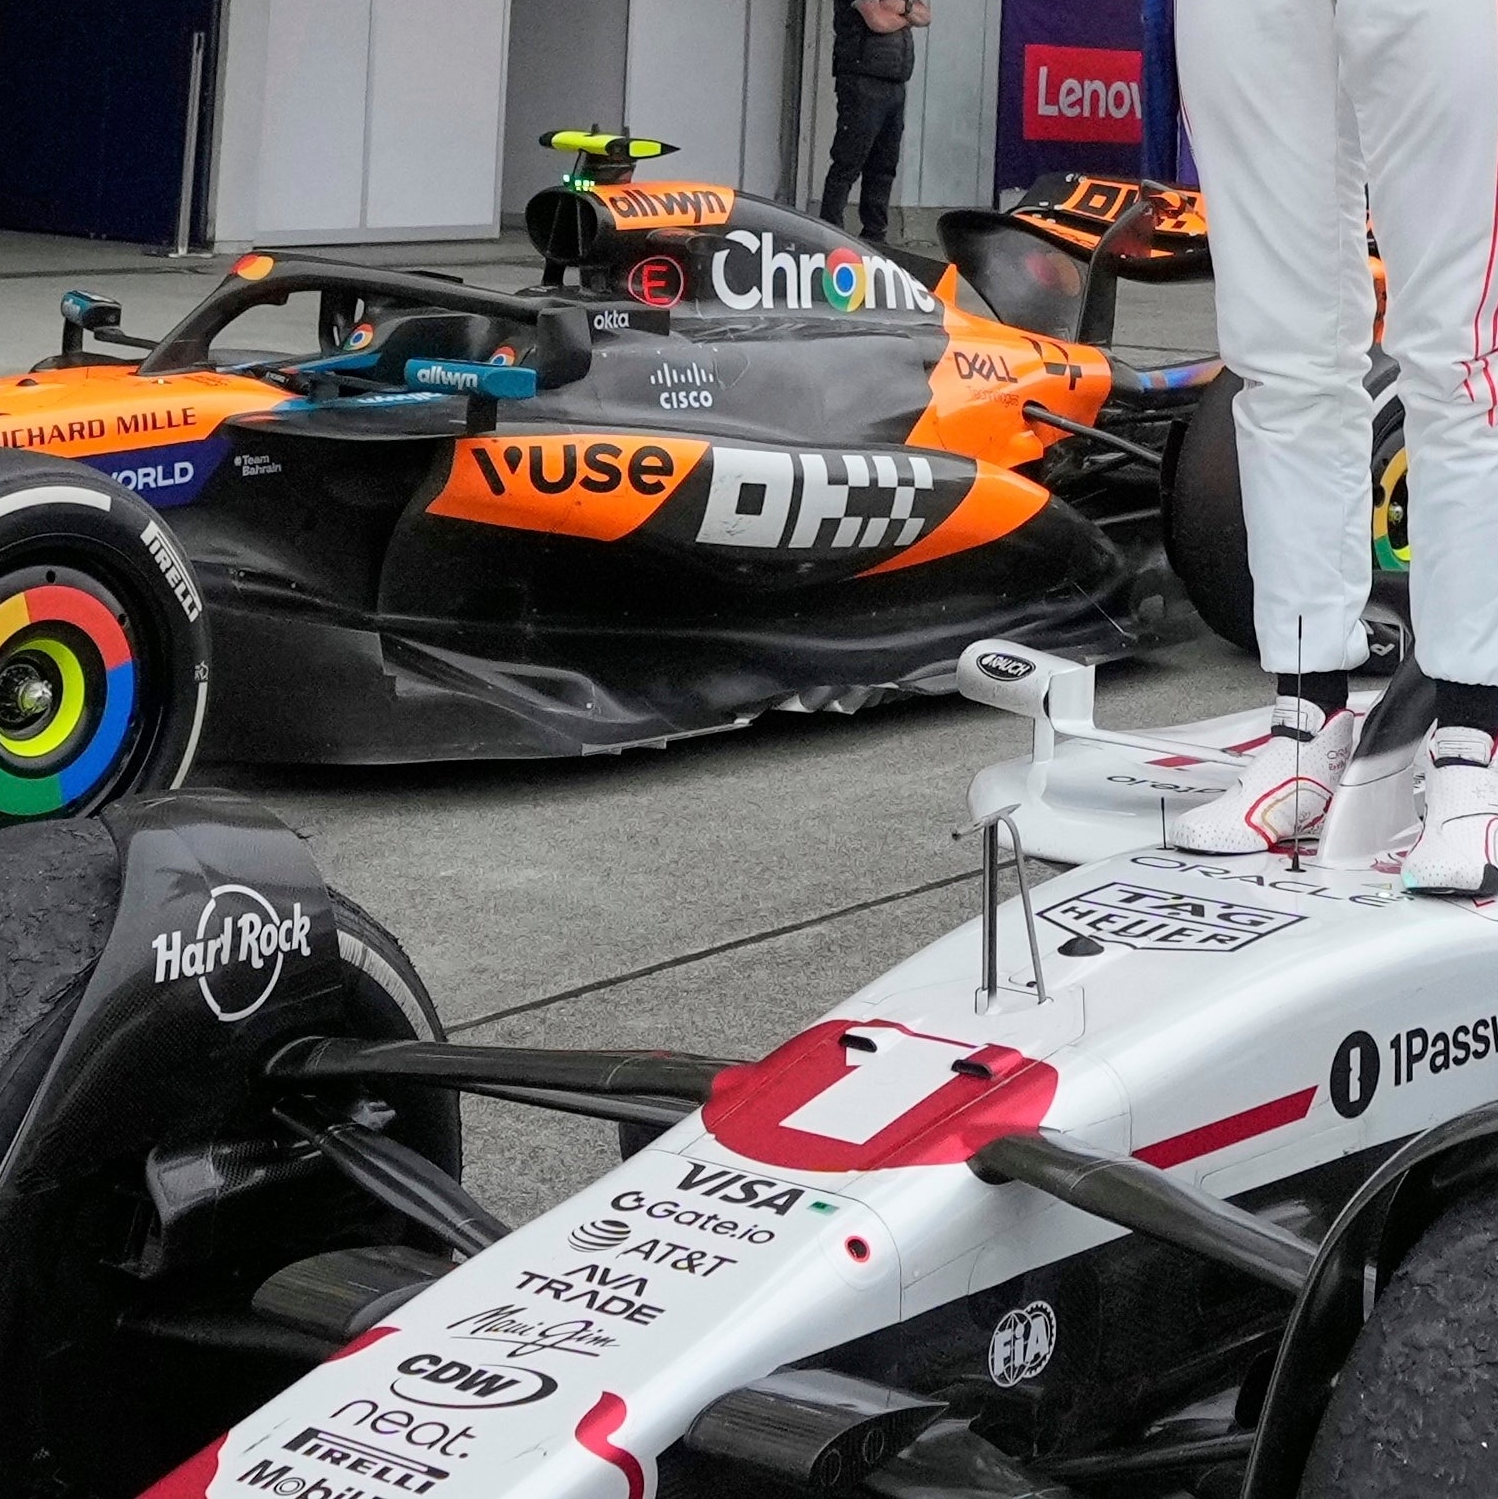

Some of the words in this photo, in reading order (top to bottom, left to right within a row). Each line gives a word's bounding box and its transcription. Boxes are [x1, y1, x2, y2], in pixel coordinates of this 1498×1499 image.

[607, 188, 728, 224] allwyn
[593, 310, 630, 330] okta
[416, 365, 479, 391] allwyn
[953, 351, 1019, 384] DELL
[116, 407, 198, 435] MILLE
[242, 463, 282, 478] Bahrain
[139, 519, 203, 624] PIRELLI
[990, 655, 1031, 678] RAUCH
[1106, 773, 1224, 796] ate.io
[1057, 903, 1245, 948] HEUER
[1112, 887, 1278, 927] TAG
[236, 902, 312, 970] Rock
[778, 1027, 961, 1146] 1
[682, 1160, 810, 1217] VISA
[645, 1200, 776, 1248] Gate.io
[623, 1238, 738, 1278] AT&T
[515, 1269, 669, 1327] TRADE
[561, 1263, 649, 1297] AVA
[446, 1304, 534, 1342] Maui
[531, 1318, 621, 1357] Jim
[396, 1352, 523, 1398] CDW
[281, 1425, 451, 1495] PIRELLI
